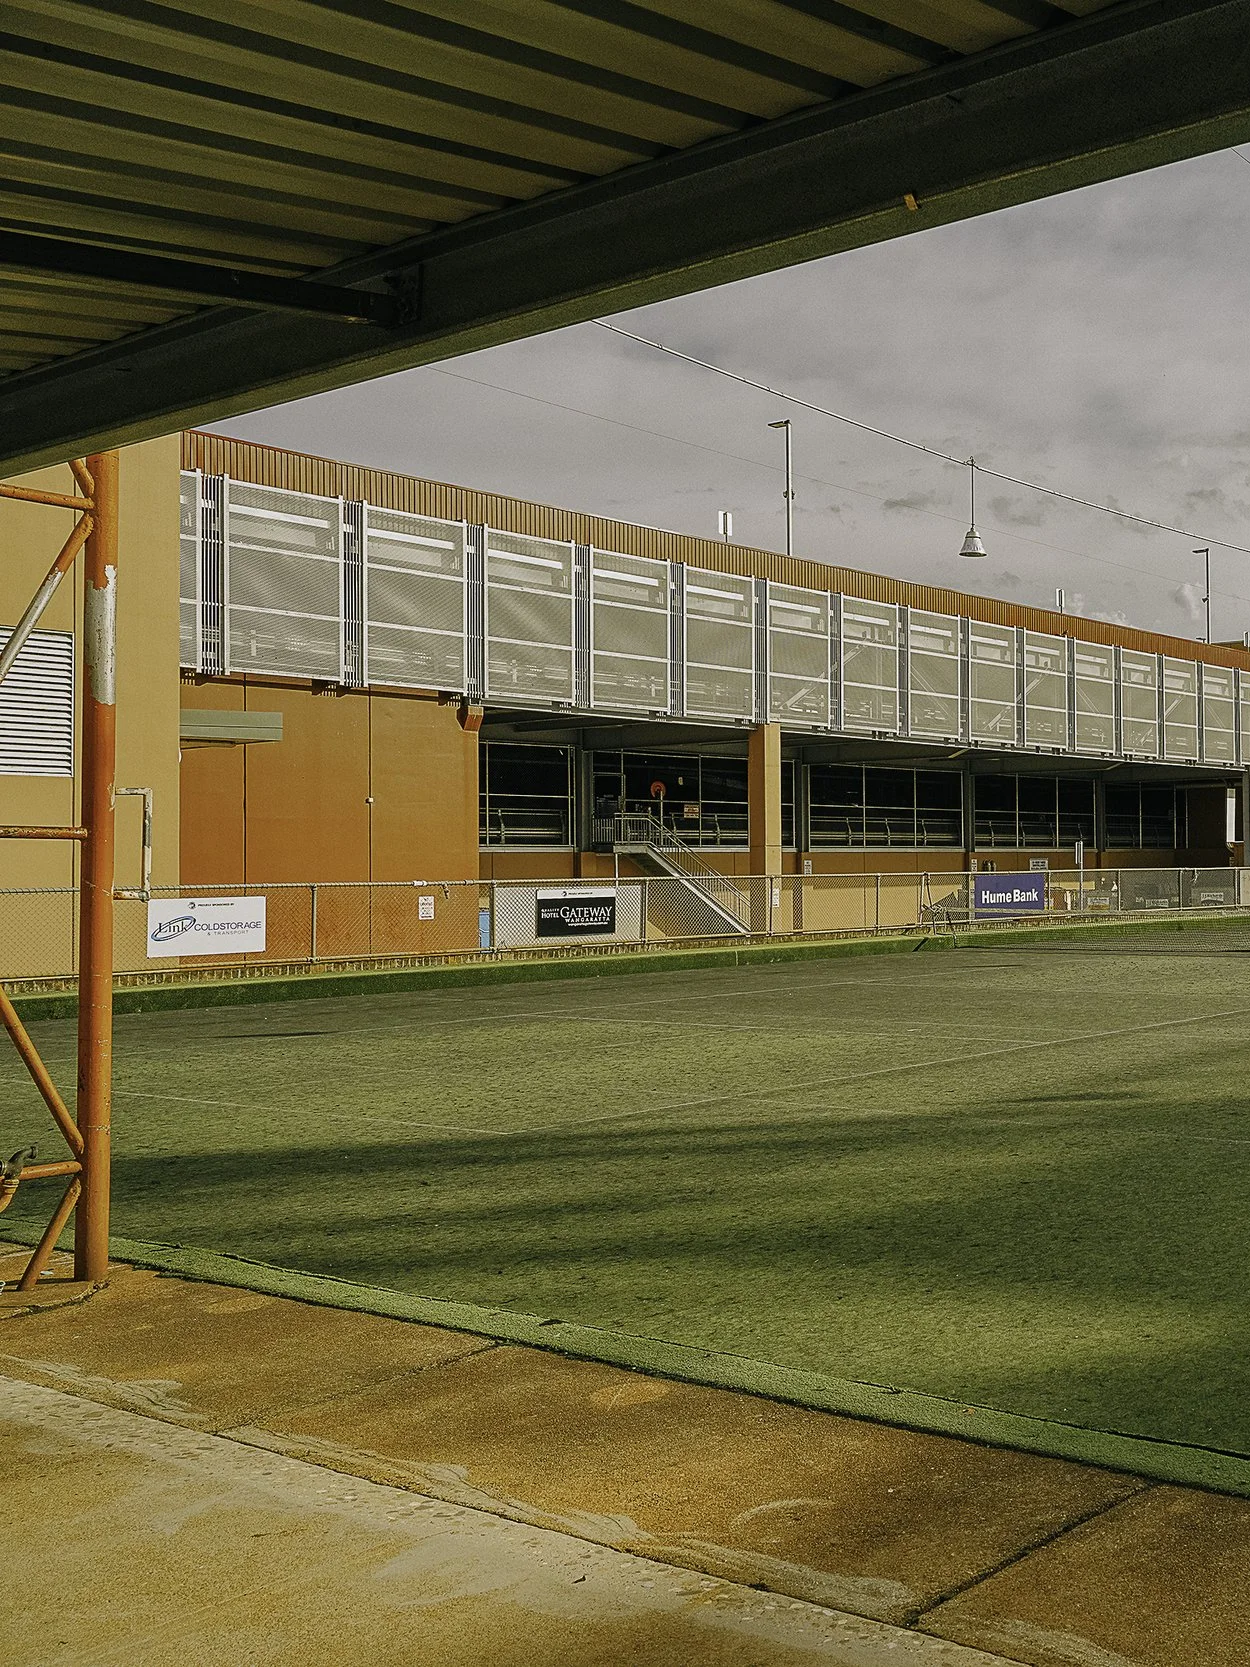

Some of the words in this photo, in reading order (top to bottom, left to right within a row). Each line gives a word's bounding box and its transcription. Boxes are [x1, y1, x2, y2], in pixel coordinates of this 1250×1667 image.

[981, 890, 1012, 904] Hume
[1013, 888, 1039, 902] Bank
[560, 906, 613, 919] GATEWAY
[158, 920, 188, 934] Link
[194, 921, 262, 932] COLDSTORAGE
